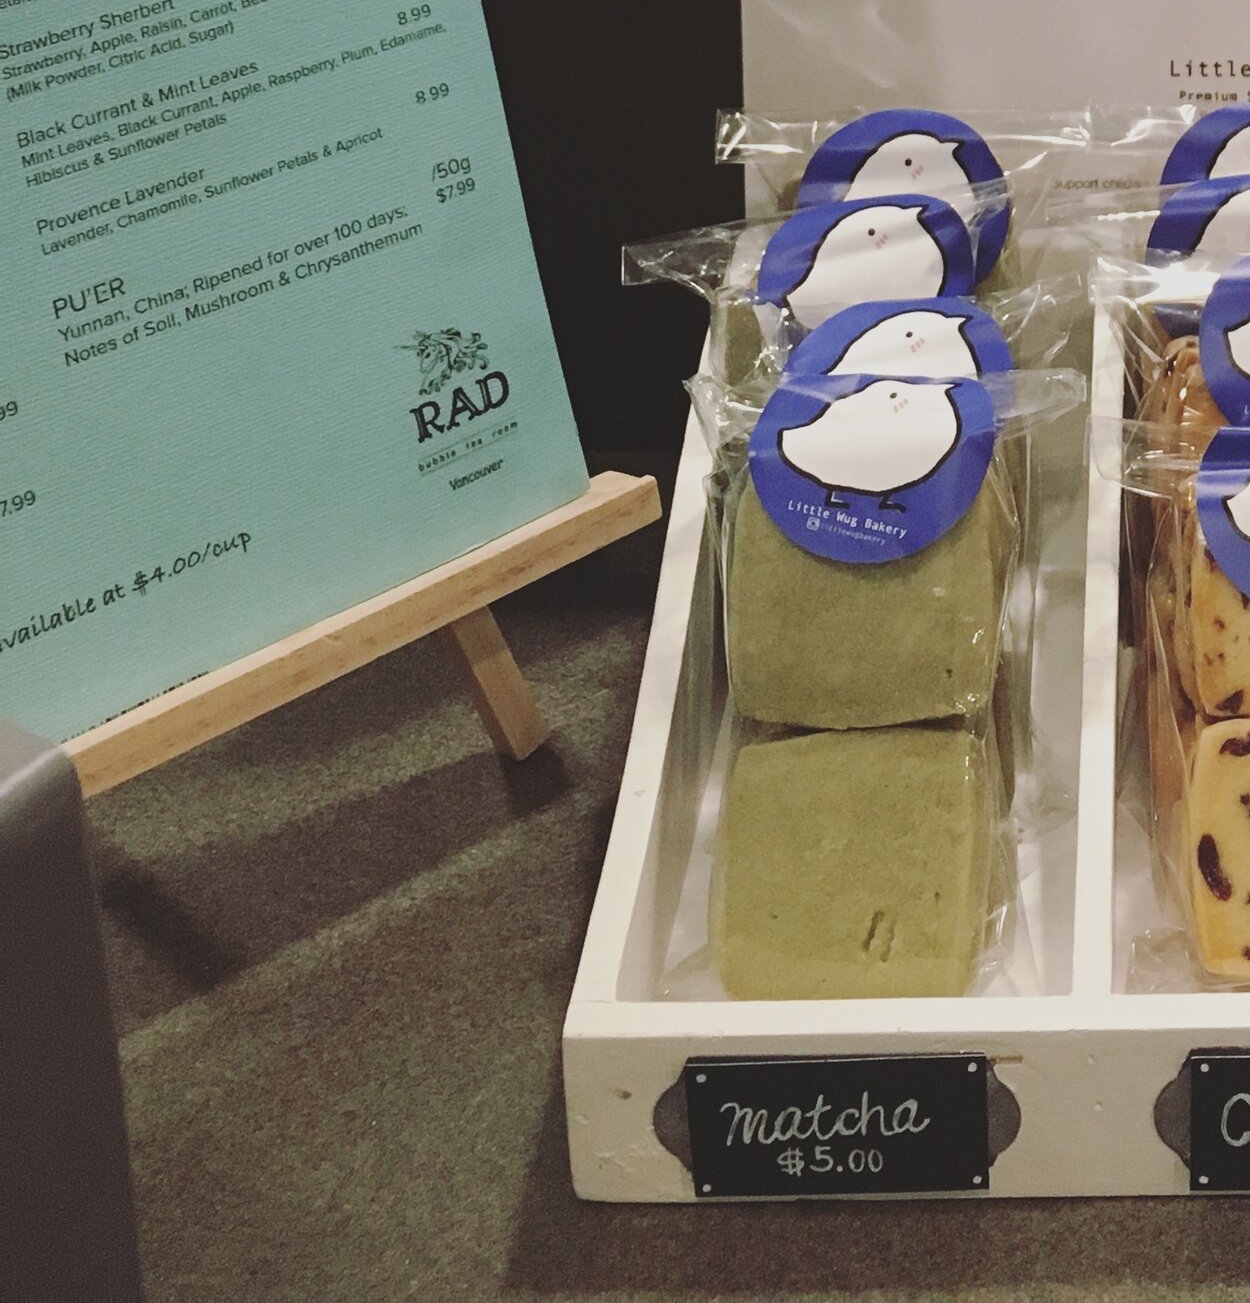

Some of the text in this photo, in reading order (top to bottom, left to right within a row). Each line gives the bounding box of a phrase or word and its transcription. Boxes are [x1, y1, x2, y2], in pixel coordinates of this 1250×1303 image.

[397, 4, 432, 26] 8.99
[0, 22, 94, 60] Strawberry
[6, 80, 42, 103] (Milk
[108, 50, 145, 68] Citric
[189, 20, 234, 44] Sugar)
[16, 62, 259, 149] Black Currant & Mint Leaves
[415, 83, 450, 104] 8.99
[1179, 90, 1238, 102] Premium
[21, 148, 55, 168] Mint
[117, 116, 158, 137] Black
[25, 114, 227, 187] Hibiscus & Sunflower Petals
[204, 167, 274, 198] Sunflower
[277, 151, 319, 172] Petals
[323, 145, 332, 157] &
[336, 128, 383, 153] Apricot
[431, 156, 472, 182] /50g
[435, 177, 476, 204] $7.99
[36, 169, 206, 235] Provence Lavender
[192, 256, 263, 293] Ripened
[267, 249, 289, 266] for
[294, 233, 330, 256] over
[333, 220, 362, 241] 100
[52, 277, 126, 319] PU'ER
[64, 338, 118, 367] Notes
[122, 326, 139, 345] of
[185, 279, 275, 321] Mushroom
[278, 271, 291, 287] &
[294, 224, 423, 279] Chrysanthemum
[410, 371, 510, 444] RAD
[418, 450, 457, 472] bubble
[465, 438, 483, 450] tea
[449, 458, 504, 491] Vancouver
[788, 498, 908, 540] Little Wug Bakery
[102, 583, 126, 606] at
[131, 532, 252, 596] $4.00/cup
